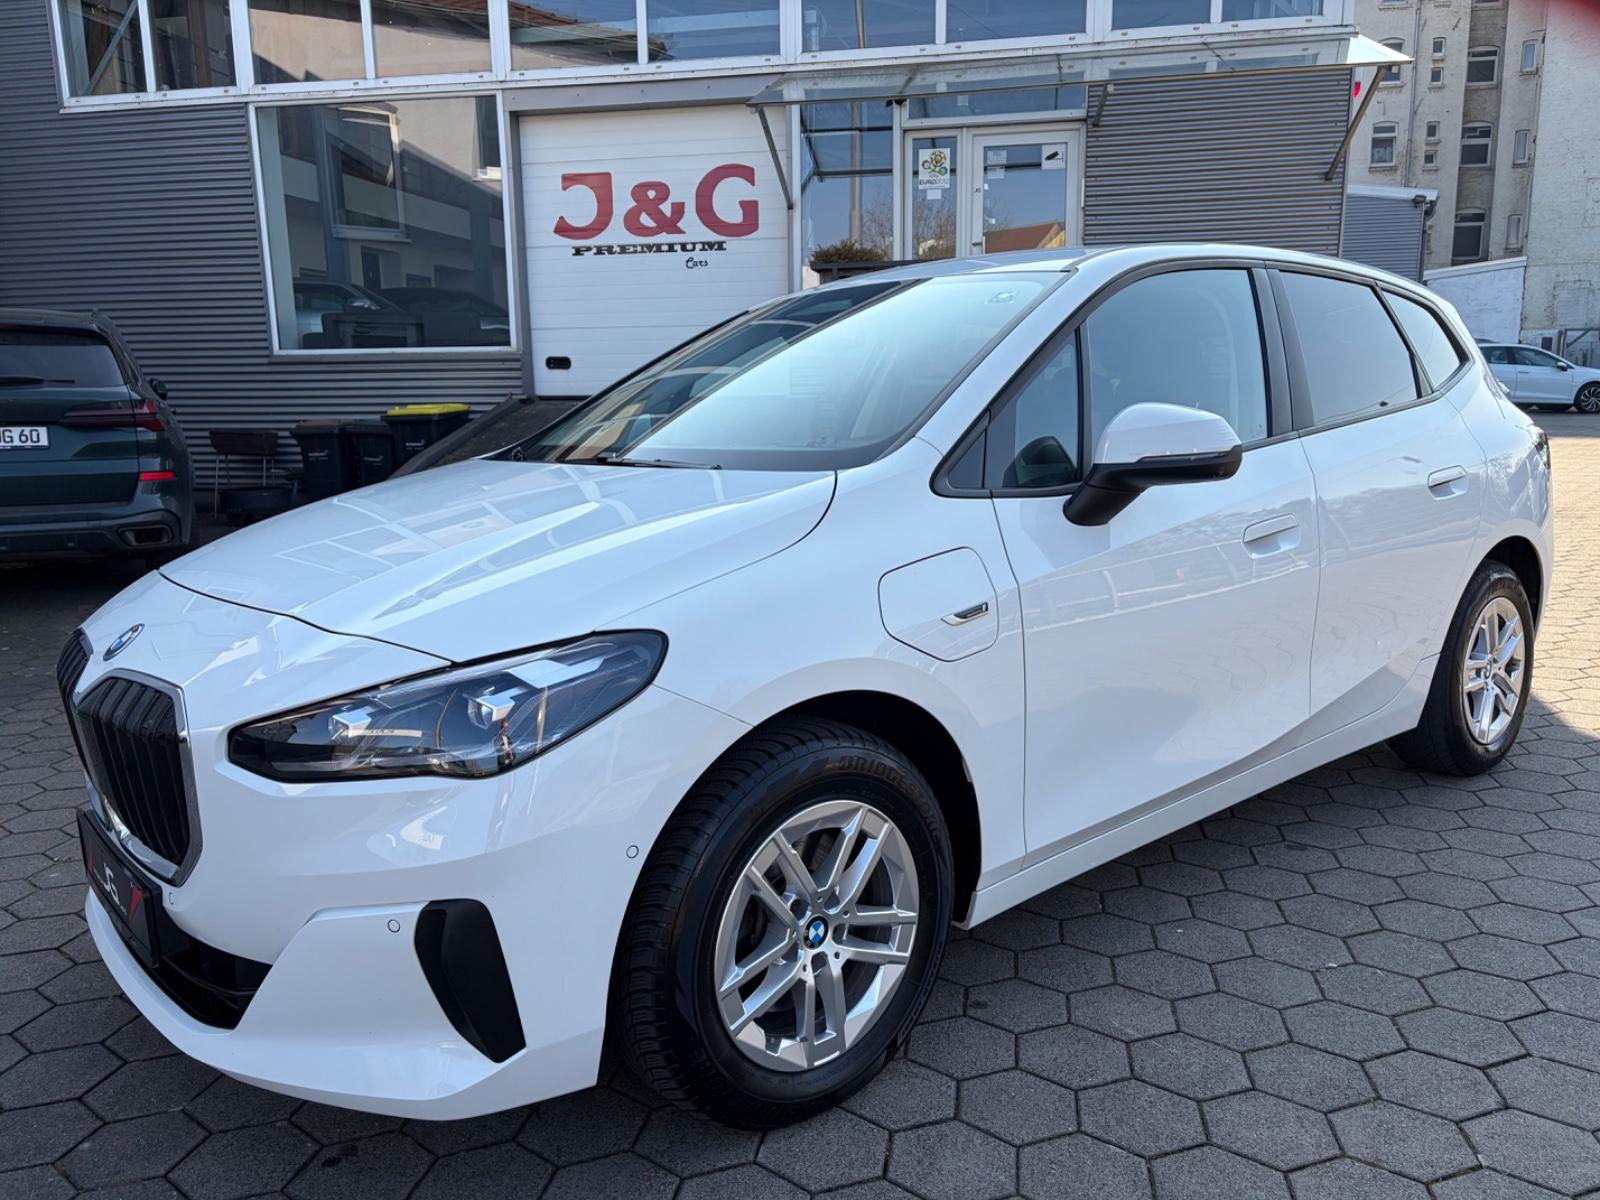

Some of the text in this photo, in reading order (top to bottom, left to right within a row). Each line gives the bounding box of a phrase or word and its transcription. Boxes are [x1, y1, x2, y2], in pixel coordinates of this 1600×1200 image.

[553, 163, 760, 240] J&G
[572, 241, 727, 256] PREMIUM
[685, 257, 708, 269] Cars
[0, 429, 40, 444] G 60
